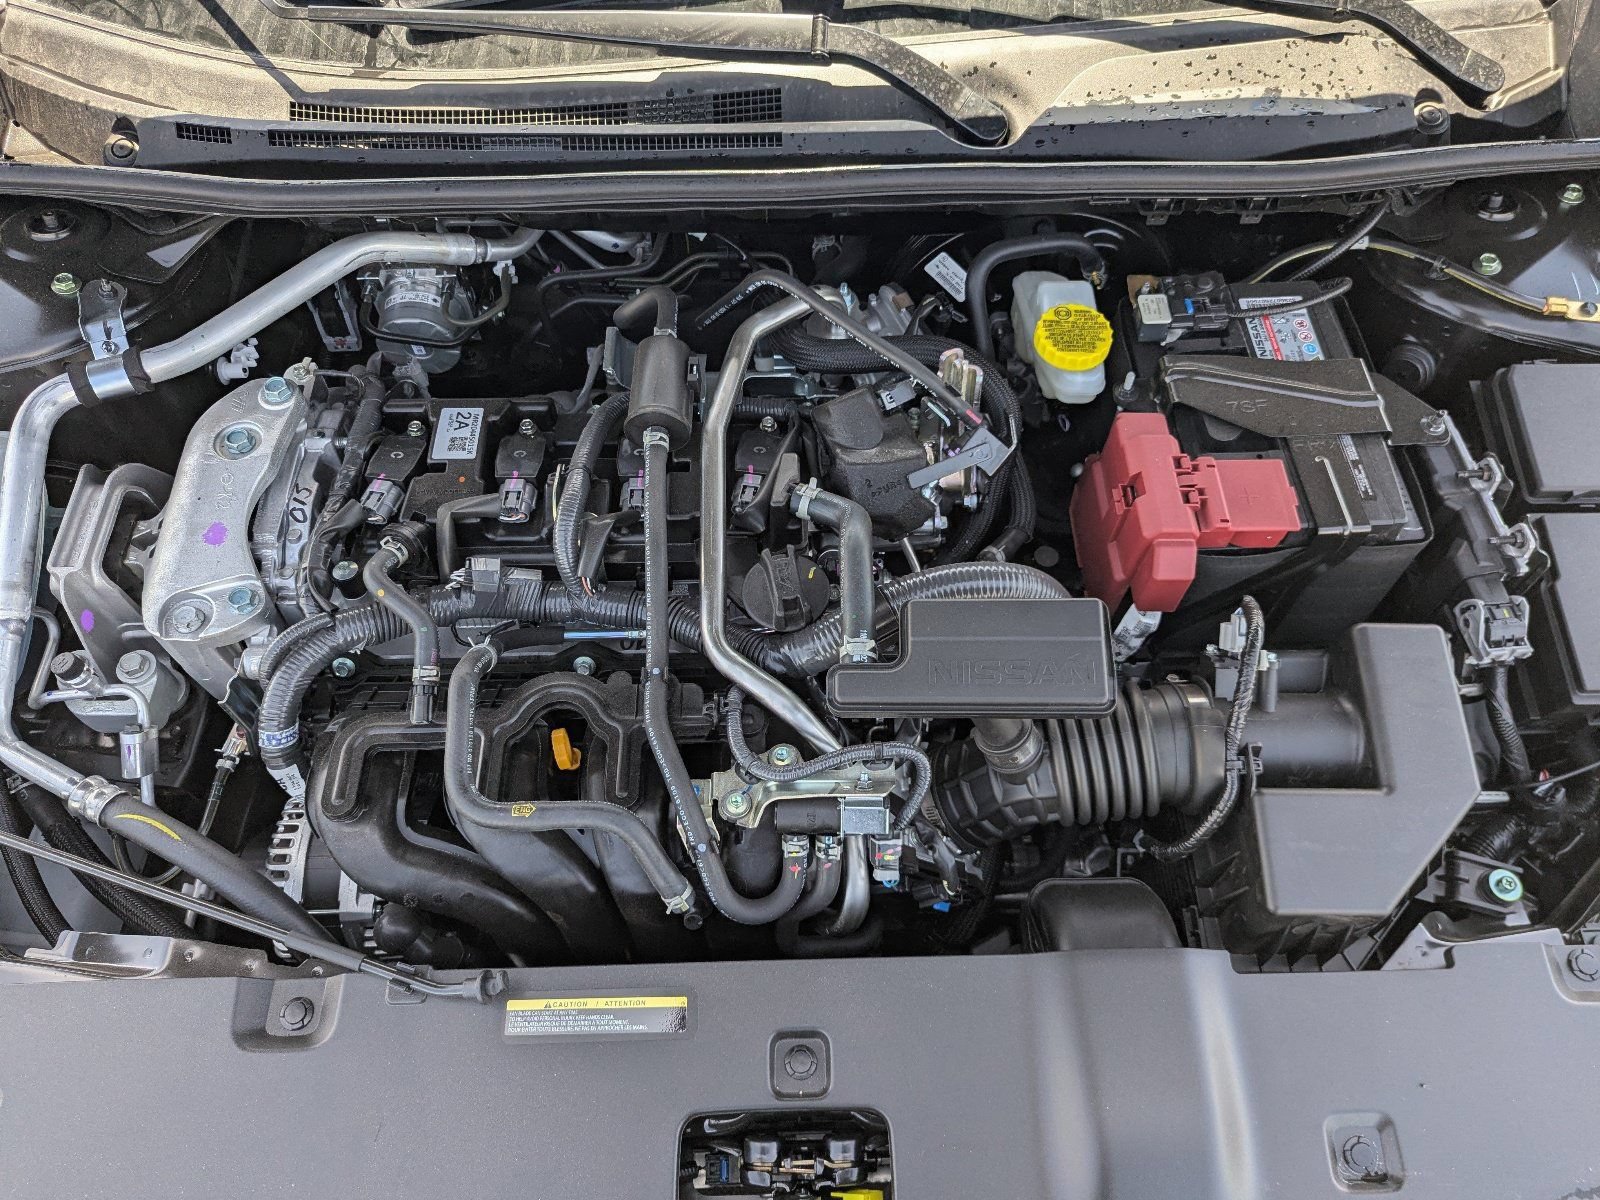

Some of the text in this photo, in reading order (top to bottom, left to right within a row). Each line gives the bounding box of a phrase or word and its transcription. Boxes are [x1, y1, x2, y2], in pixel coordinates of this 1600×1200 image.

[1248, 315, 1268, 357] NISSAN
[453, 411, 473, 431] 2A
[927, 658, 1098, 686] NISSAN
[514, 806, 531, 814] ENG
